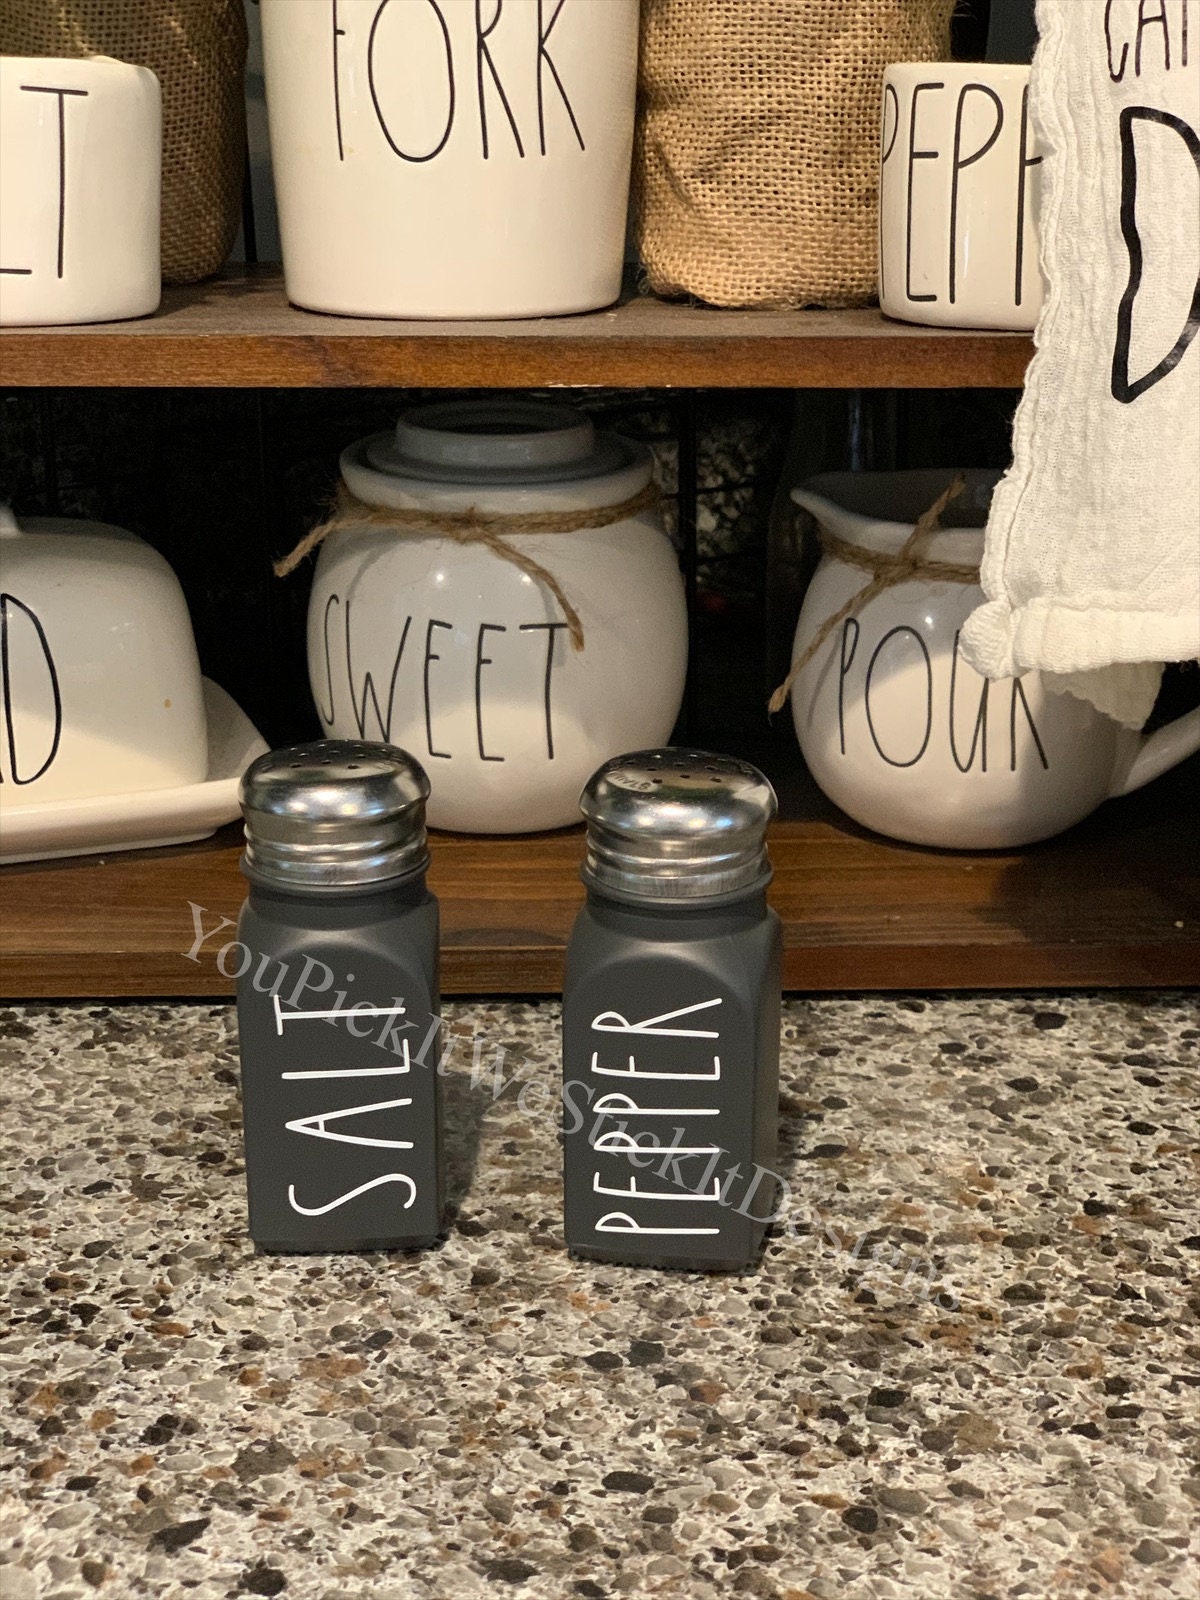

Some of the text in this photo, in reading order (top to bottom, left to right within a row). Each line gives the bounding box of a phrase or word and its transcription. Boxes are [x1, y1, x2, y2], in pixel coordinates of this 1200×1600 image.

[331, 0, 586, 162] FORK
[0, 85, 88, 278] T
[0, 593, 62, 785] D
[320, 594, 568, 761] SWEET
[273, 994, 417, 1216] SALT
[591, 998, 722, 1235] PEPPER
